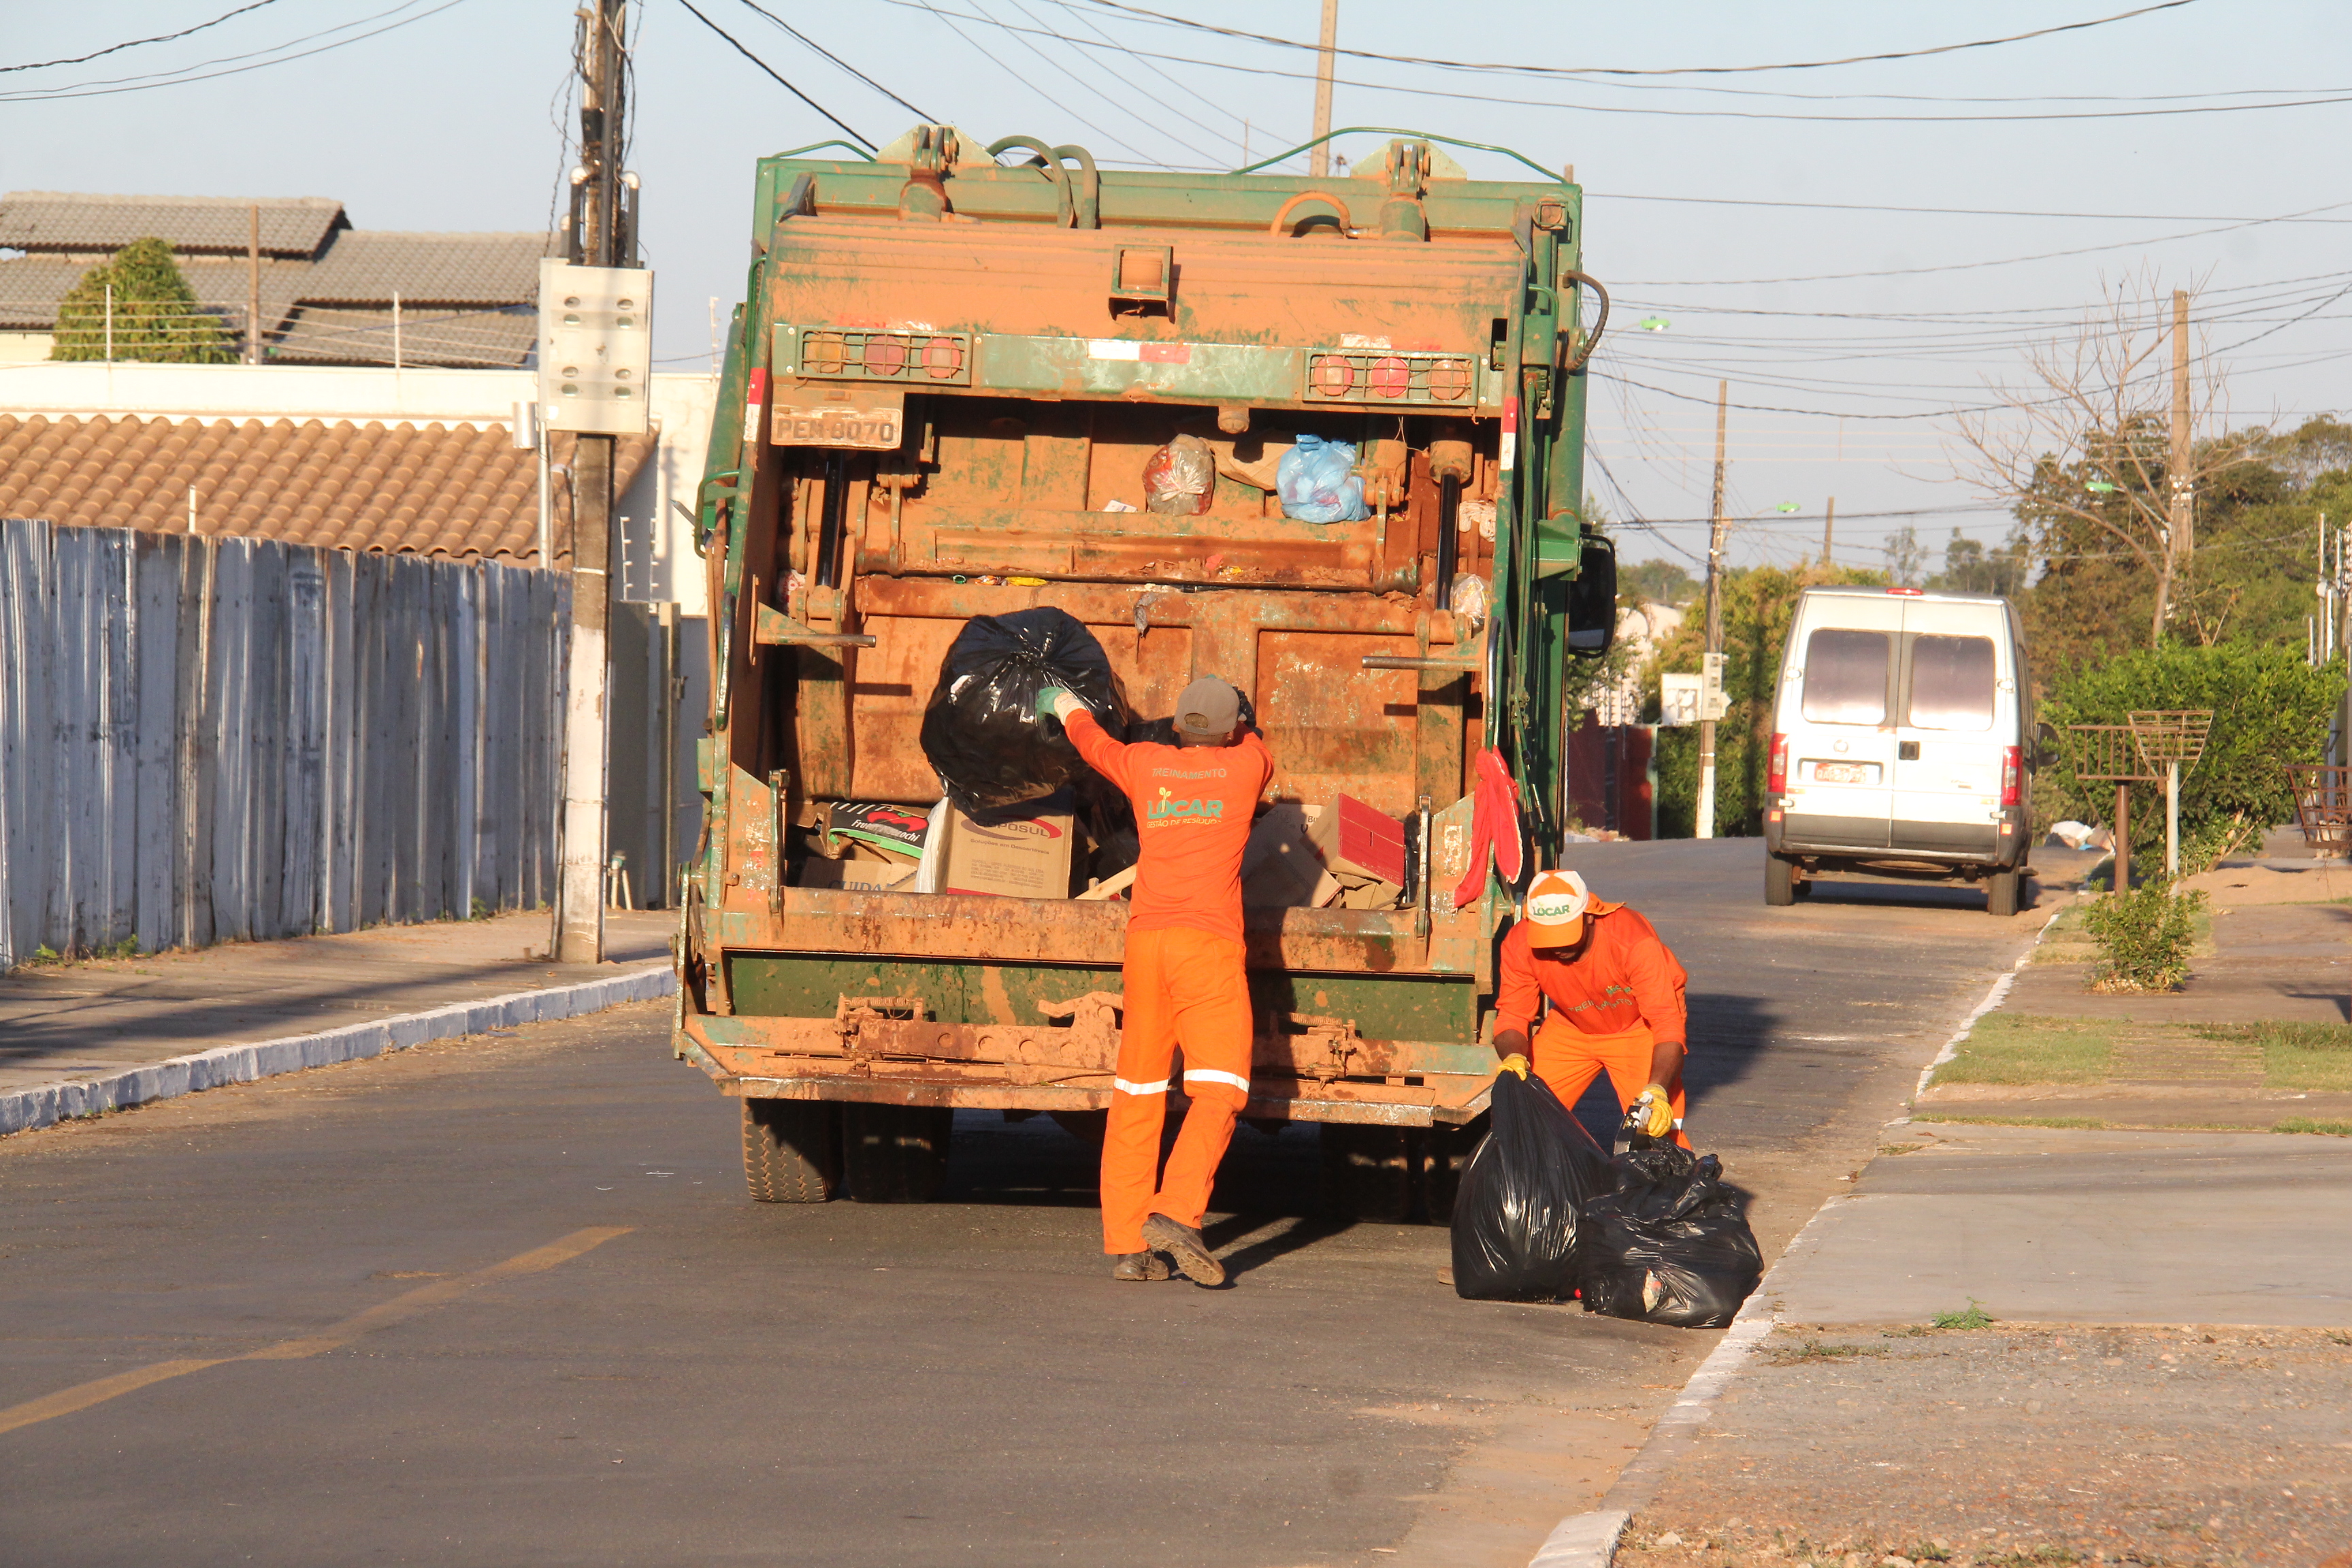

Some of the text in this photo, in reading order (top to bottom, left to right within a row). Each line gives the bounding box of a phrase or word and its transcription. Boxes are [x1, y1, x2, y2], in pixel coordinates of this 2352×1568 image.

[1152, 768, 1226, 779] TREINAMENTO
[1147, 799, 1223, 819] LOCAR
[1147, 820, 1169, 828] GESTÃO
[1011, 844, 1049, 855] Descartáveis
[829, 880, 890, 891] CUIDA
[1533, 904, 1570, 916] LOCAR
[1605, 985, 1633, 995] LOCR
[1568, 999, 1633, 1012] TREIMNTO
